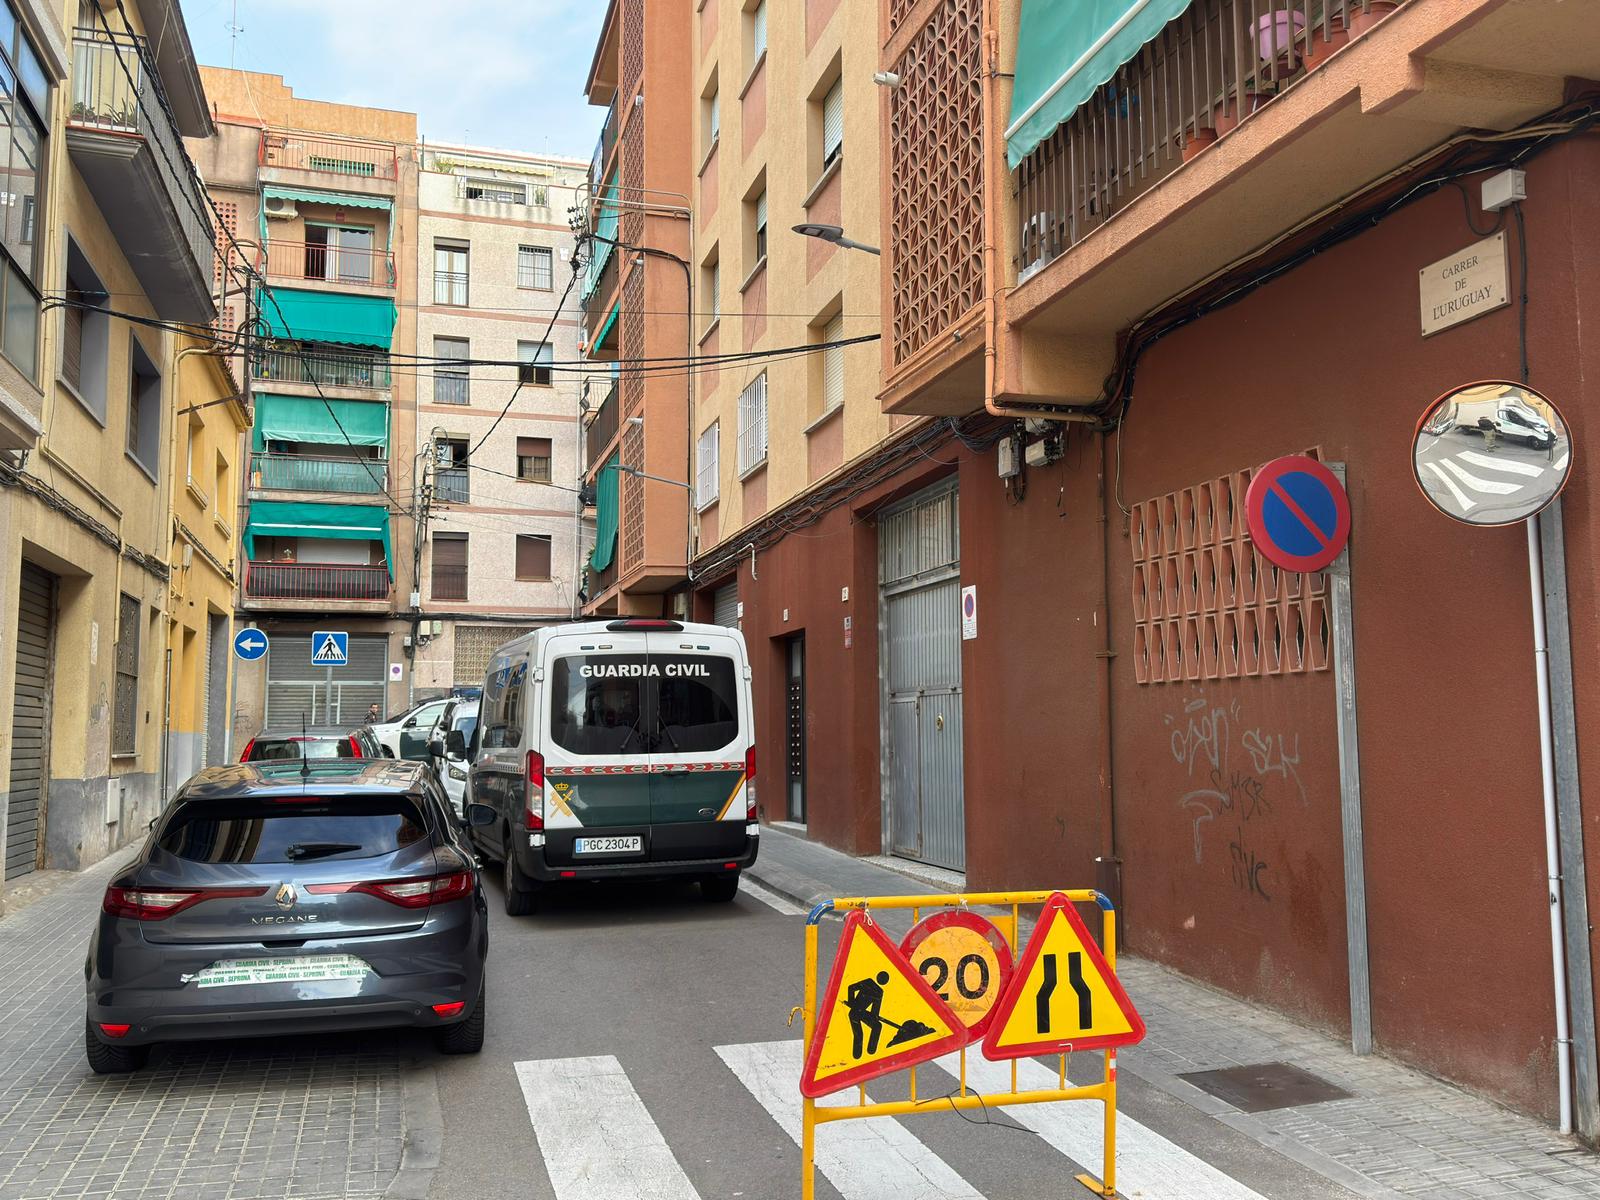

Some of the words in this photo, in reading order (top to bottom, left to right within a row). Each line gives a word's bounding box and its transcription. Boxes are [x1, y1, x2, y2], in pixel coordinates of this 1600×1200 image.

[1442, 256, 1479, 279] CARRER
[1455, 278, 1467, 291] DE
[1433, 285, 1492, 320] L'URUGUAY
[579, 664, 660, 677] GUARDIA
[665, 664, 710, 676] CIVIL
[583, 840, 603, 851] PGC
[605, 838, 630, 850] 2304
[632, 838, 639, 848] P
[250, 914, 318, 925] MEGANE
[919, 953, 989, 1001] 20
